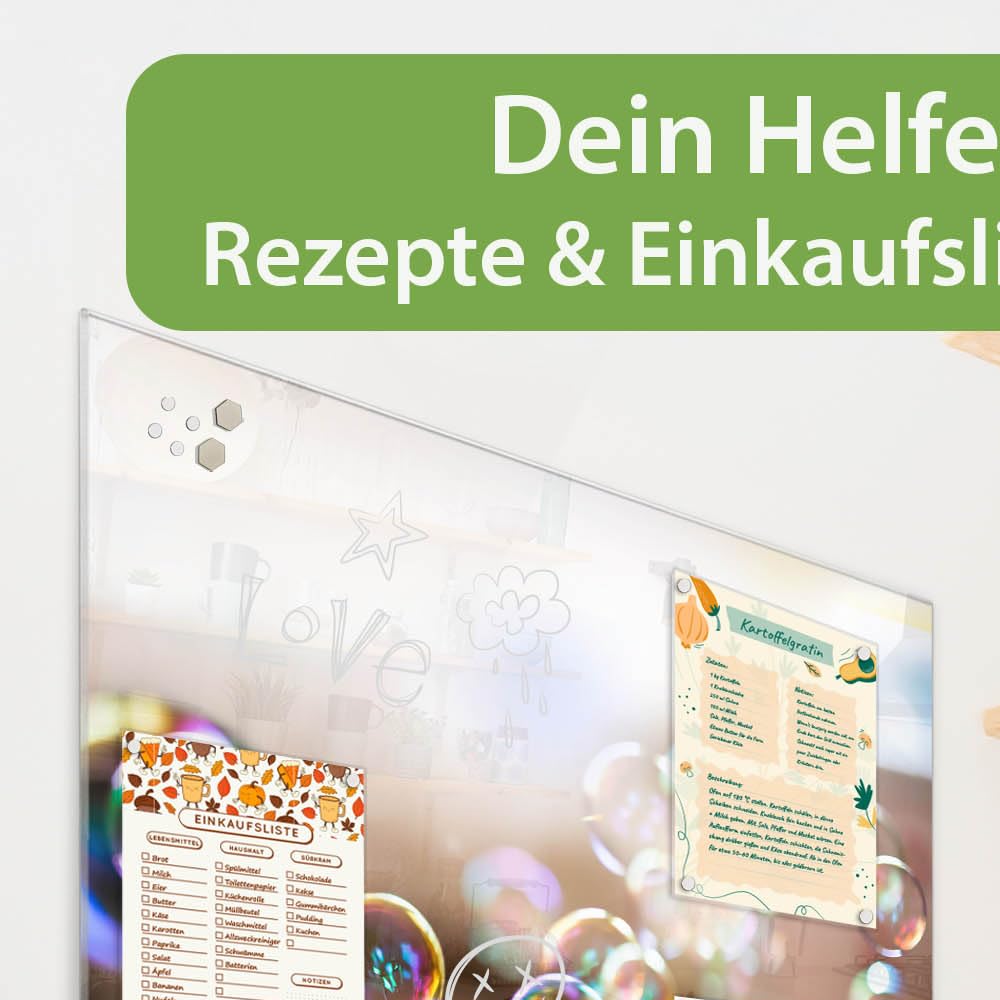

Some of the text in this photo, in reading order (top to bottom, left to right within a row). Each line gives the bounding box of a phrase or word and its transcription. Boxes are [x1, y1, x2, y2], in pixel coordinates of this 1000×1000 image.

[740, 618, 824, 659] Kartoffelgratin
[194, 814, 300, 838] EINKAUFSLISTE
[149, 834, 200, 847] LEBENSMITTEL
[229, 845, 264, 855] HAUSHALT
[152, 855, 168, 863] Brot
[152, 870, 172, 878] Milch
[224, 864, 261, 874] Spülmittel
[295, 873, 332, 883] Schokolade
[152, 883, 167, 891] Eier
[225, 878, 276, 891] Toilettenpapier
[296, 888, 314, 896] Kekse
[152, 897, 176, 906] Butter
[225, 892, 264, 903] Küchenrolle
[225, 906, 260, 916] Müllbeutel
[295, 901, 346, 912] Gummibärchen
[296, 914, 323, 924] Pudding
[152, 925, 184, 934] Karotten
[225, 920, 267, 930] Waschmittel
[296, 928, 320, 936] Kuchen
[152, 940, 180, 949] Paprika
[224, 933, 280, 946] Allzweckreiniger
[225, 947, 264, 958] Schwämme
[152, 954, 171, 962] Salat
[225, 961, 258, 970] Batterien
[152, 967, 172, 978] Äpfel
[302, 977, 332, 985] NOTIZEN
[152, 982, 184, 991] Bananen
